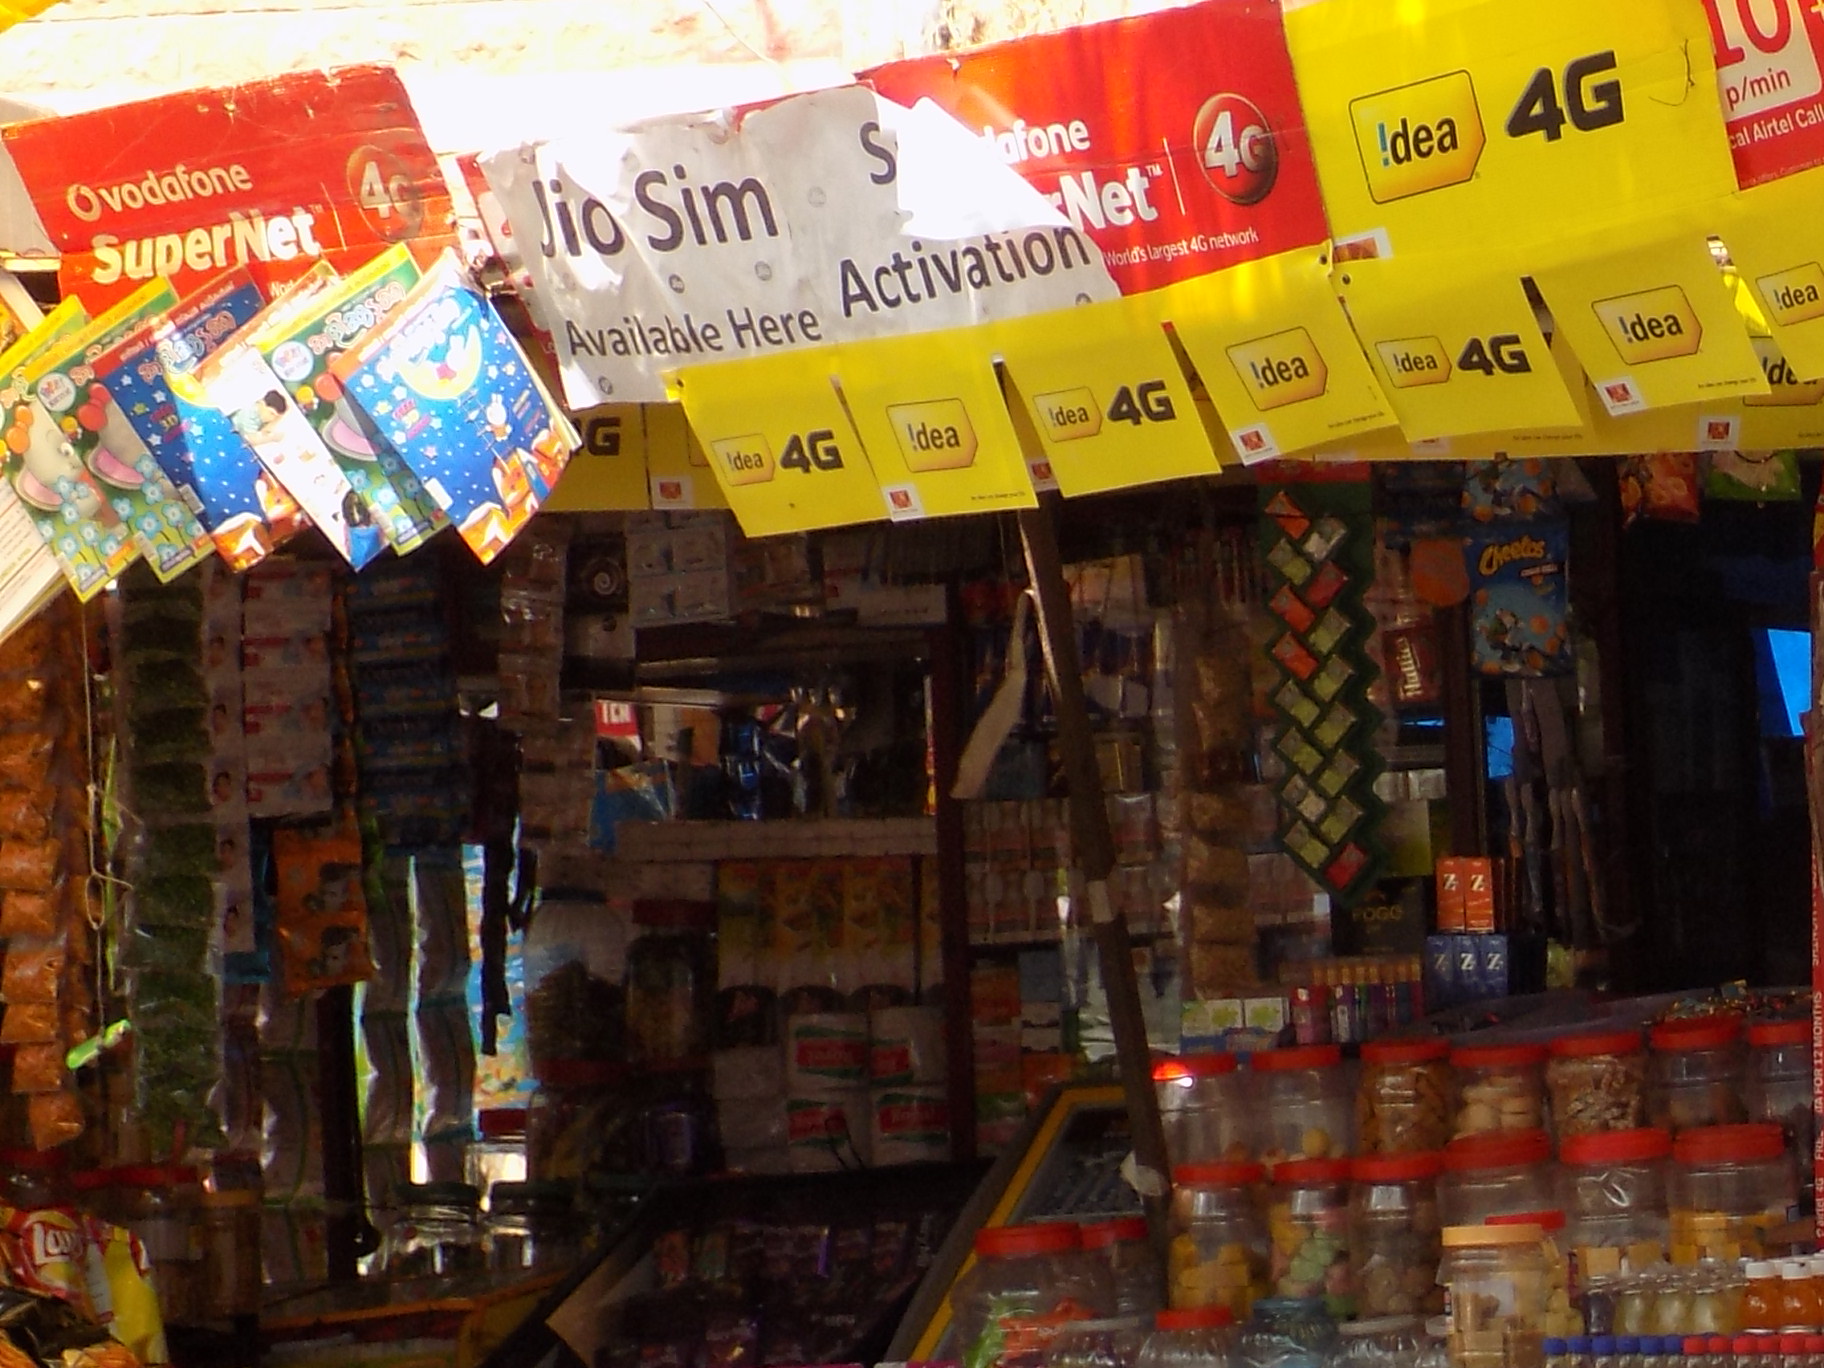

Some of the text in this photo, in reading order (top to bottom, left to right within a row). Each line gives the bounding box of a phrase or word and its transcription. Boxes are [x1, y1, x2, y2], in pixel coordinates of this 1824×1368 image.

[1504, 49, 1625, 142] 4G
[1725, 67, 1790, 108] p/min
[1204, 110, 1271, 178] 4G
[1753, 115, 1795, 143] Airtel
[101, 162, 253, 213] vodafone
[532, 163, 779, 258] Jio Sim
[91, 207, 321, 284] SuperNet
[838, 222, 1091, 318] Activation
[1103, 228, 1259, 268] World's largest 4G network
[565, 307, 823, 357] Available Here
[1457, 333, 1532, 376] 4G
[1106, 379, 1177, 427] 4G
[779, 429, 845, 474] 4G
[1477, 534, 1546, 577] Cheetos
[1814, 991, 1824, 1047] MONTHS
